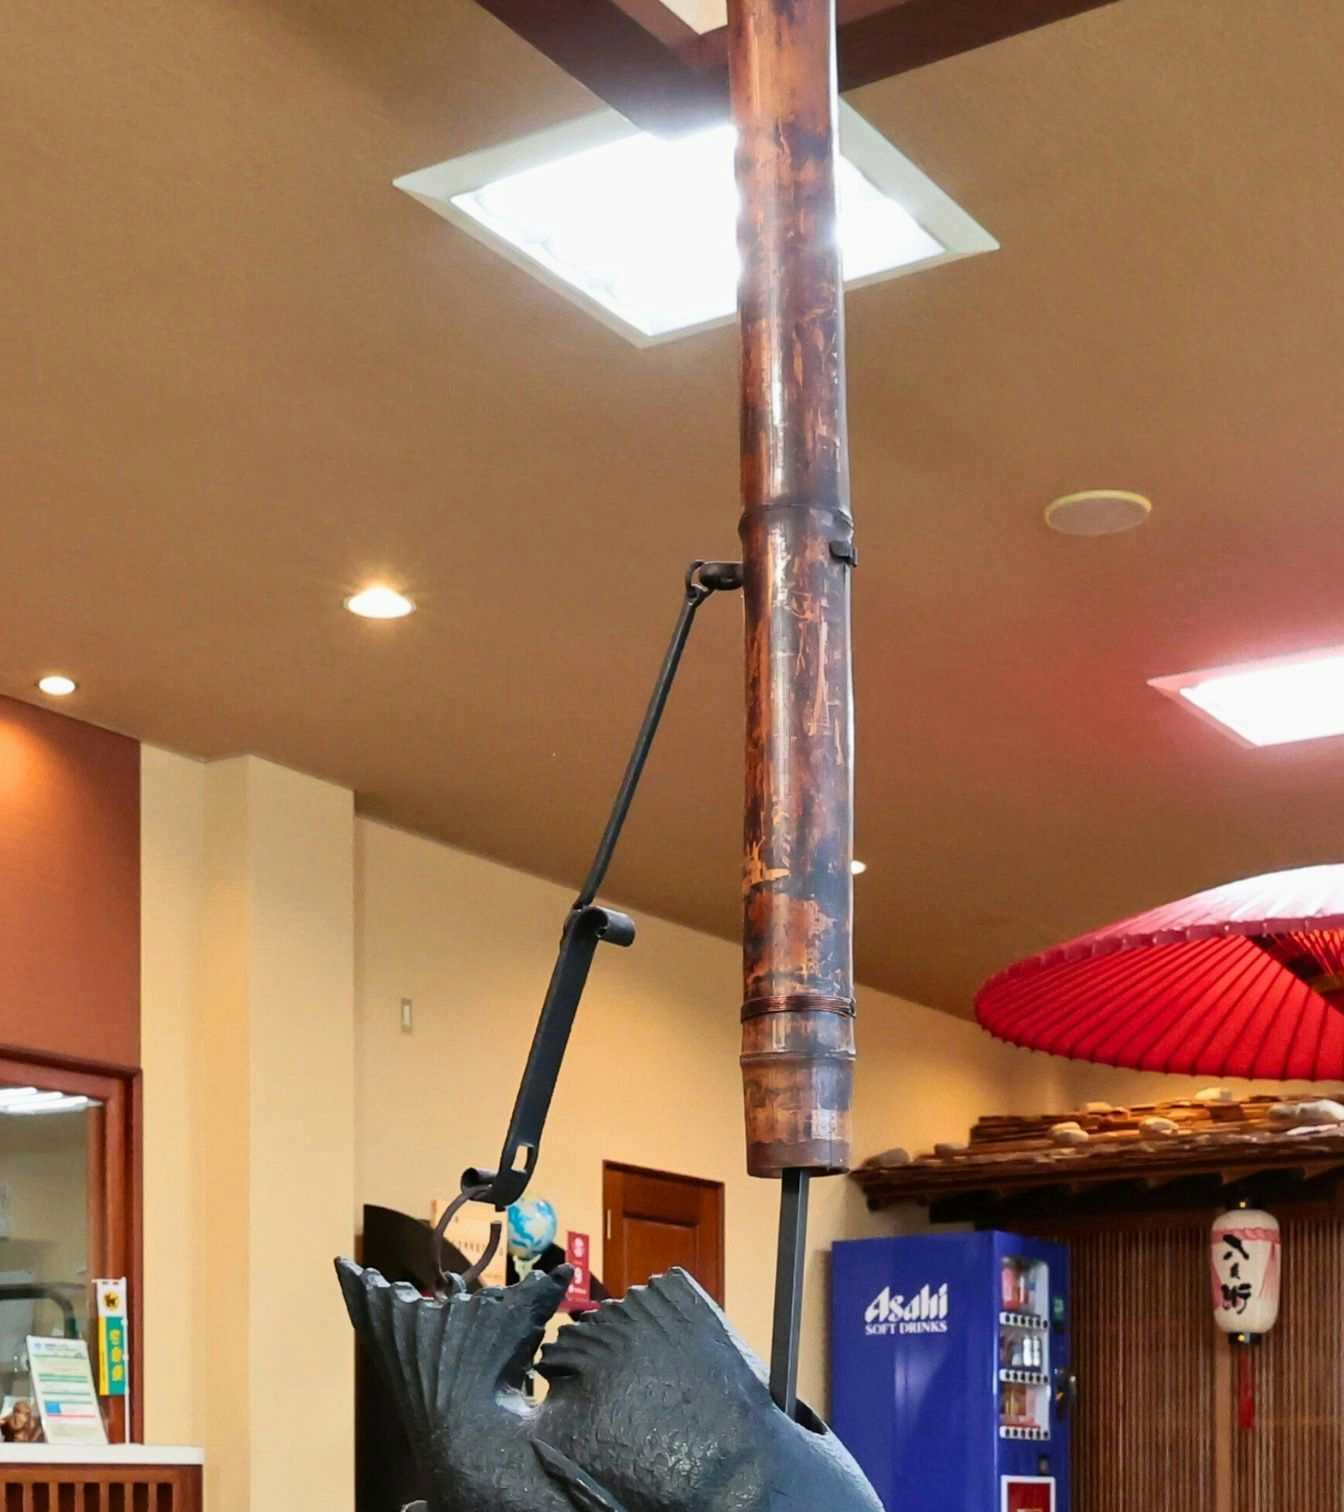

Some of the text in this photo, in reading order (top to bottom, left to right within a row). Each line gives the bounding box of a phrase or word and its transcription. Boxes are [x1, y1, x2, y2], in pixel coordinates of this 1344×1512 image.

[864, 1282, 949, 1323] Asahi
[865, 1320, 948, 1336] SOFT DRINKS
